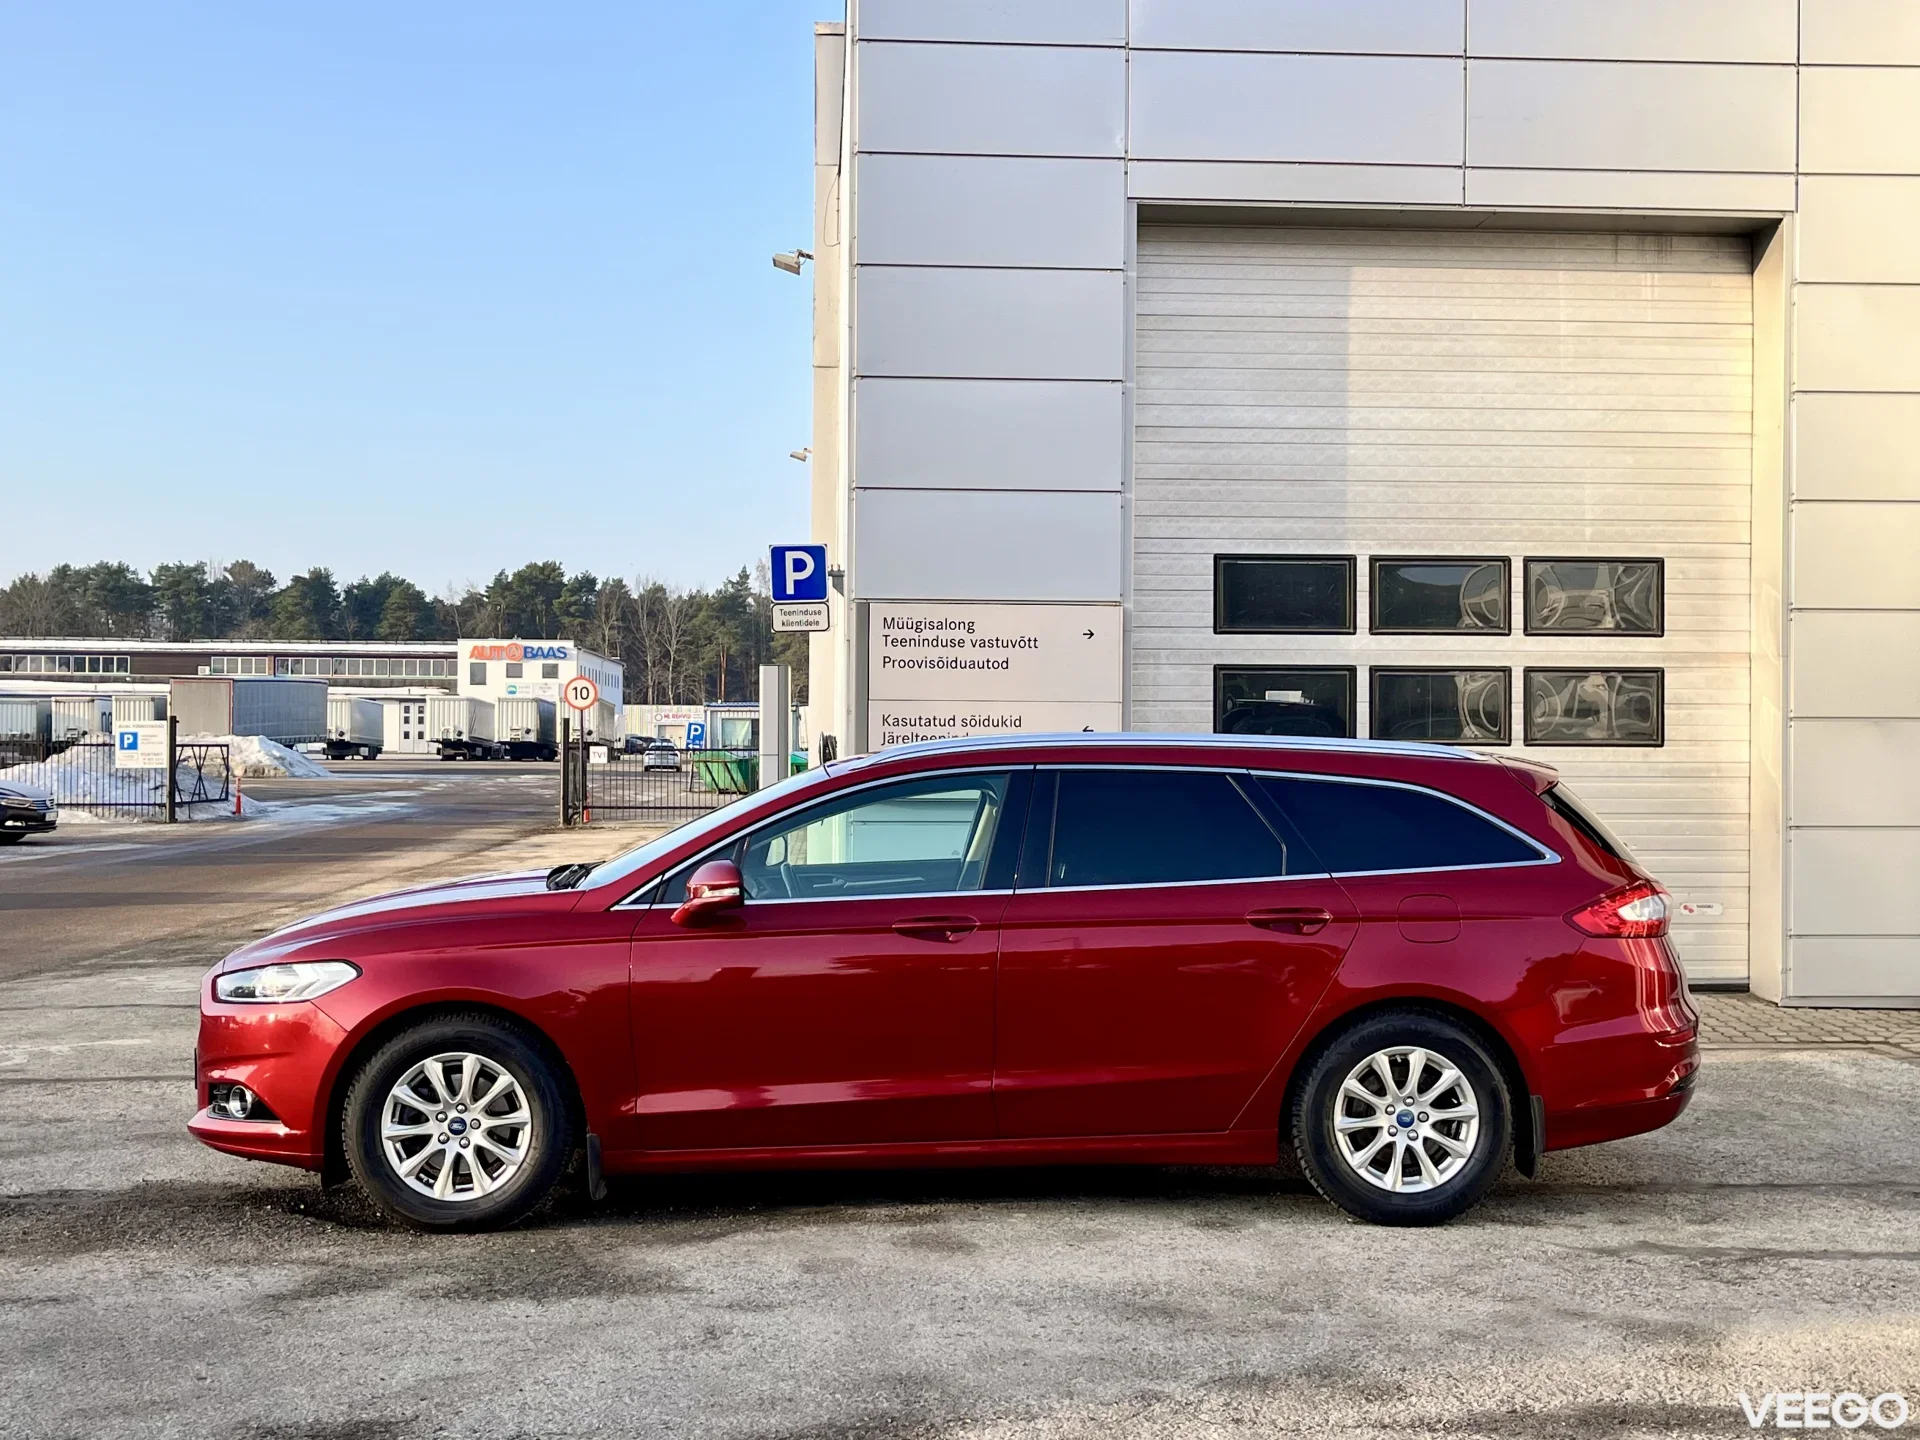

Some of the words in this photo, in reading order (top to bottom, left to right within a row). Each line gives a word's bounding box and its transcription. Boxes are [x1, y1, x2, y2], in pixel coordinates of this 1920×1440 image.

[785, 550, 815, 595] P
[779, 608, 822, 616] Teeninduse
[781, 619, 820, 627] klientidele
[882, 616, 976, 634] Müügisalong
[882, 634, 966, 648] Teeninduse
[970, 635, 1039, 649] vastuvõtt
[469, 643, 568, 661] AUTOBAAS
[882, 655, 1010, 670] Proovisõiduautod
[572, 686, 590, 700] 10
[881, 714, 956, 728] Kasutatud
[960, 714, 1022, 728] sõidukid
[123, 734, 134, 748] P
